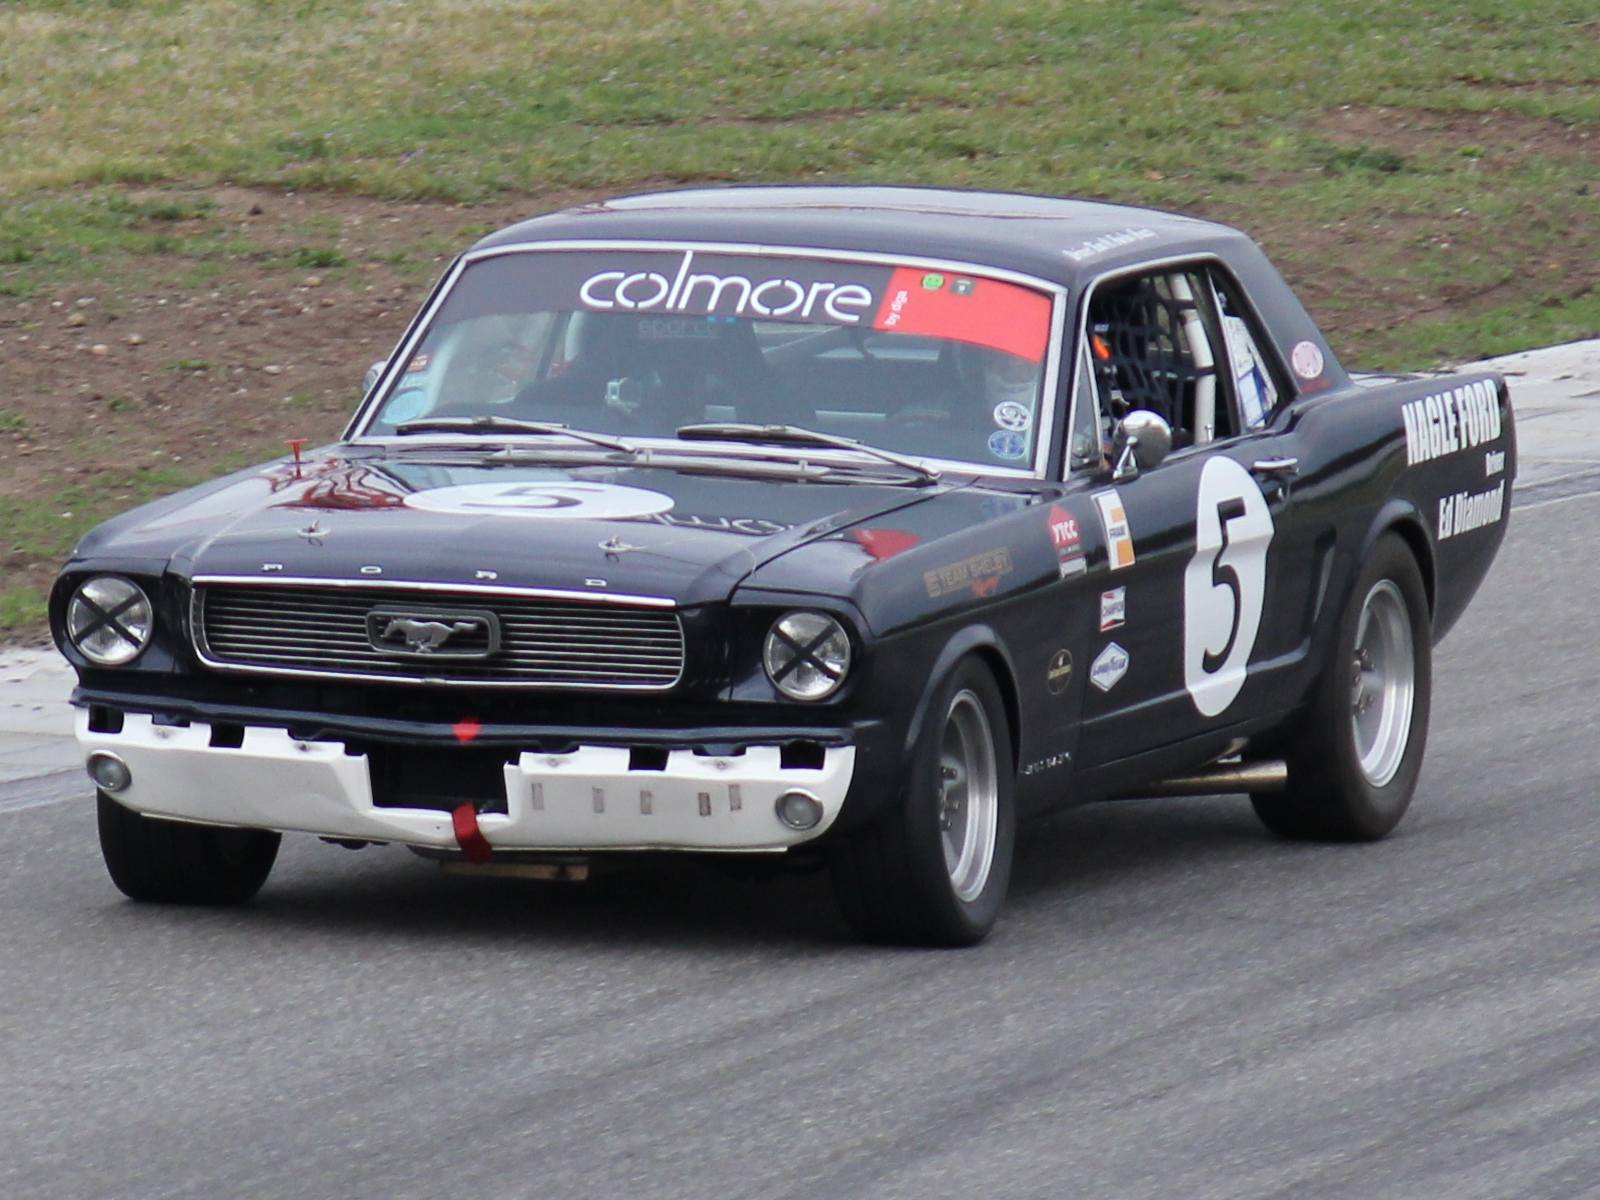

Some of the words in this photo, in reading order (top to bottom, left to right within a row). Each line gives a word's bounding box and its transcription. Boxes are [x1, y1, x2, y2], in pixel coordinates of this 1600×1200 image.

[580, 250, 872, 321] colmore
[884, 311, 901, 326] by
[1401, 391, 1459, 467] NAGLE
[1454, 379, 1502, 450] FORD
[460, 486, 606, 510] 5
[1438, 495, 1455, 541] Ed
[1452, 479, 1506, 536] Diamond
[1051, 519, 1079, 544] YTCC
[1202, 496, 1247, 674] 5
